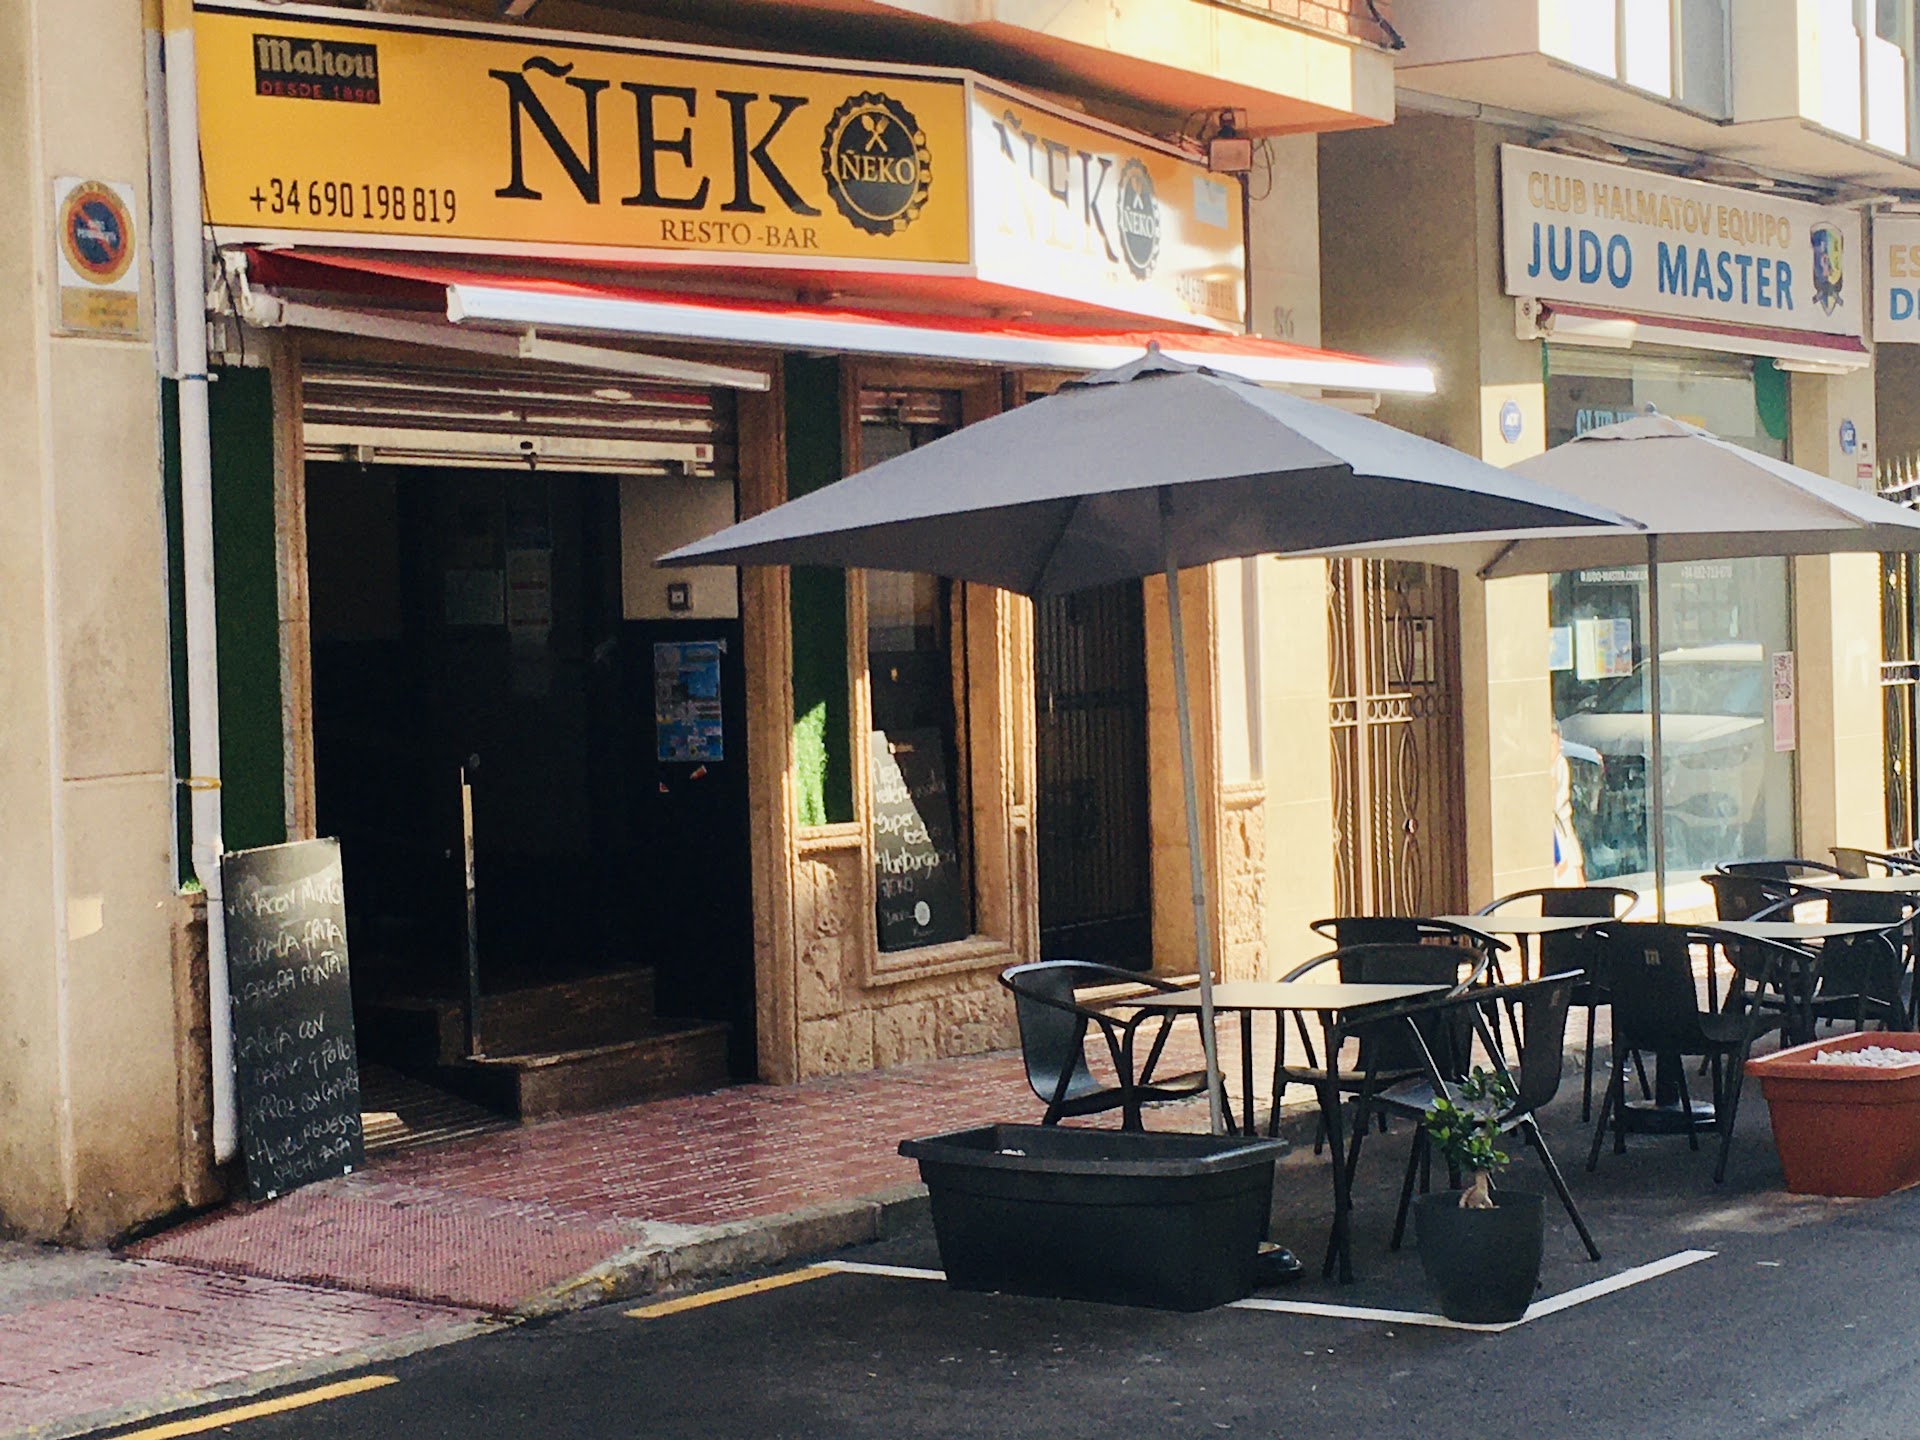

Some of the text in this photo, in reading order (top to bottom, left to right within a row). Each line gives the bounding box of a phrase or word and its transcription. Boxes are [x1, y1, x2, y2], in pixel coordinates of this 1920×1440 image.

[257, 37, 376, 79] Mahou
[260, 80, 323, 101] DESDE
[840, 151, 917, 186] ÑEKO
[249, 179, 457, 224] +34 690 198 819
[1527, 170, 1792, 249] CLUB HALMATOV EQUIPO
[1527, 222, 1795, 311] JUDO MASTER
